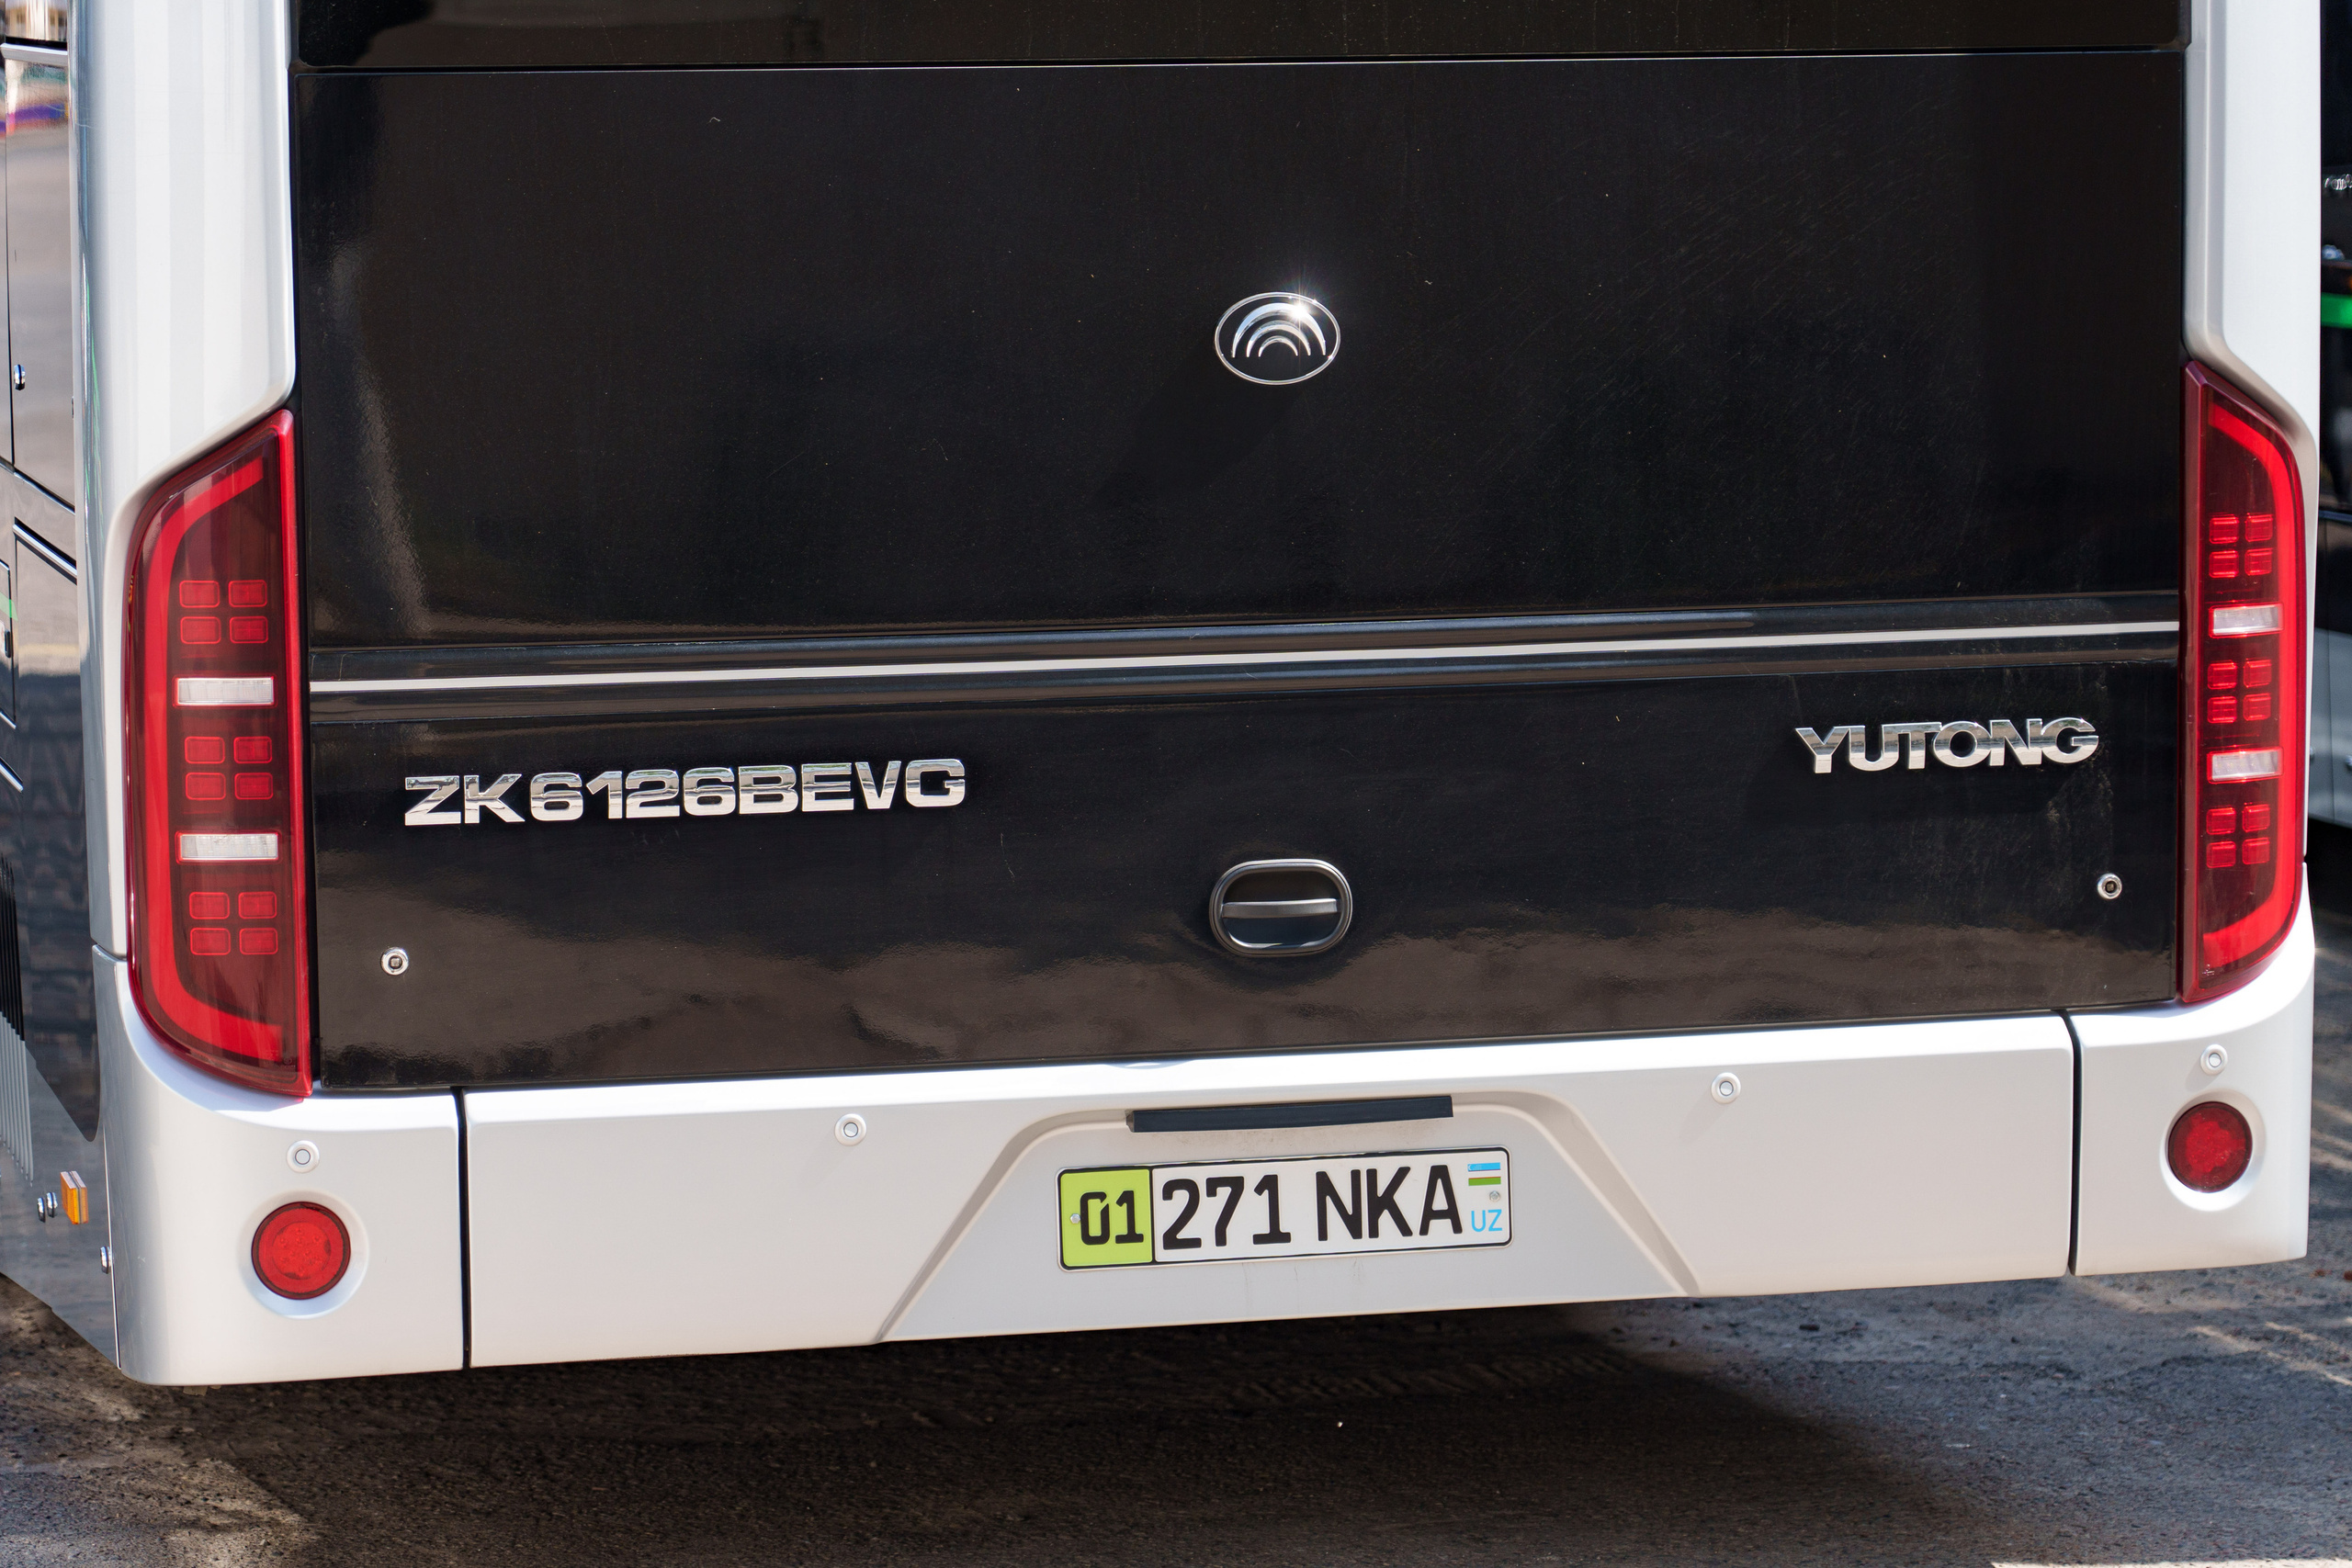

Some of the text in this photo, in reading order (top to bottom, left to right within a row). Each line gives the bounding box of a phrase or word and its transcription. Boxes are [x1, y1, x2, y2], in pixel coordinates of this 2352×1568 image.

[1794, 716, 2099, 774] YUTONG
[404, 759, 966, 826] ZK6126BEVG
[1080, 1164, 1464, 1250] 01 271 NKA
[1471, 1209, 1503, 1233] UZ
